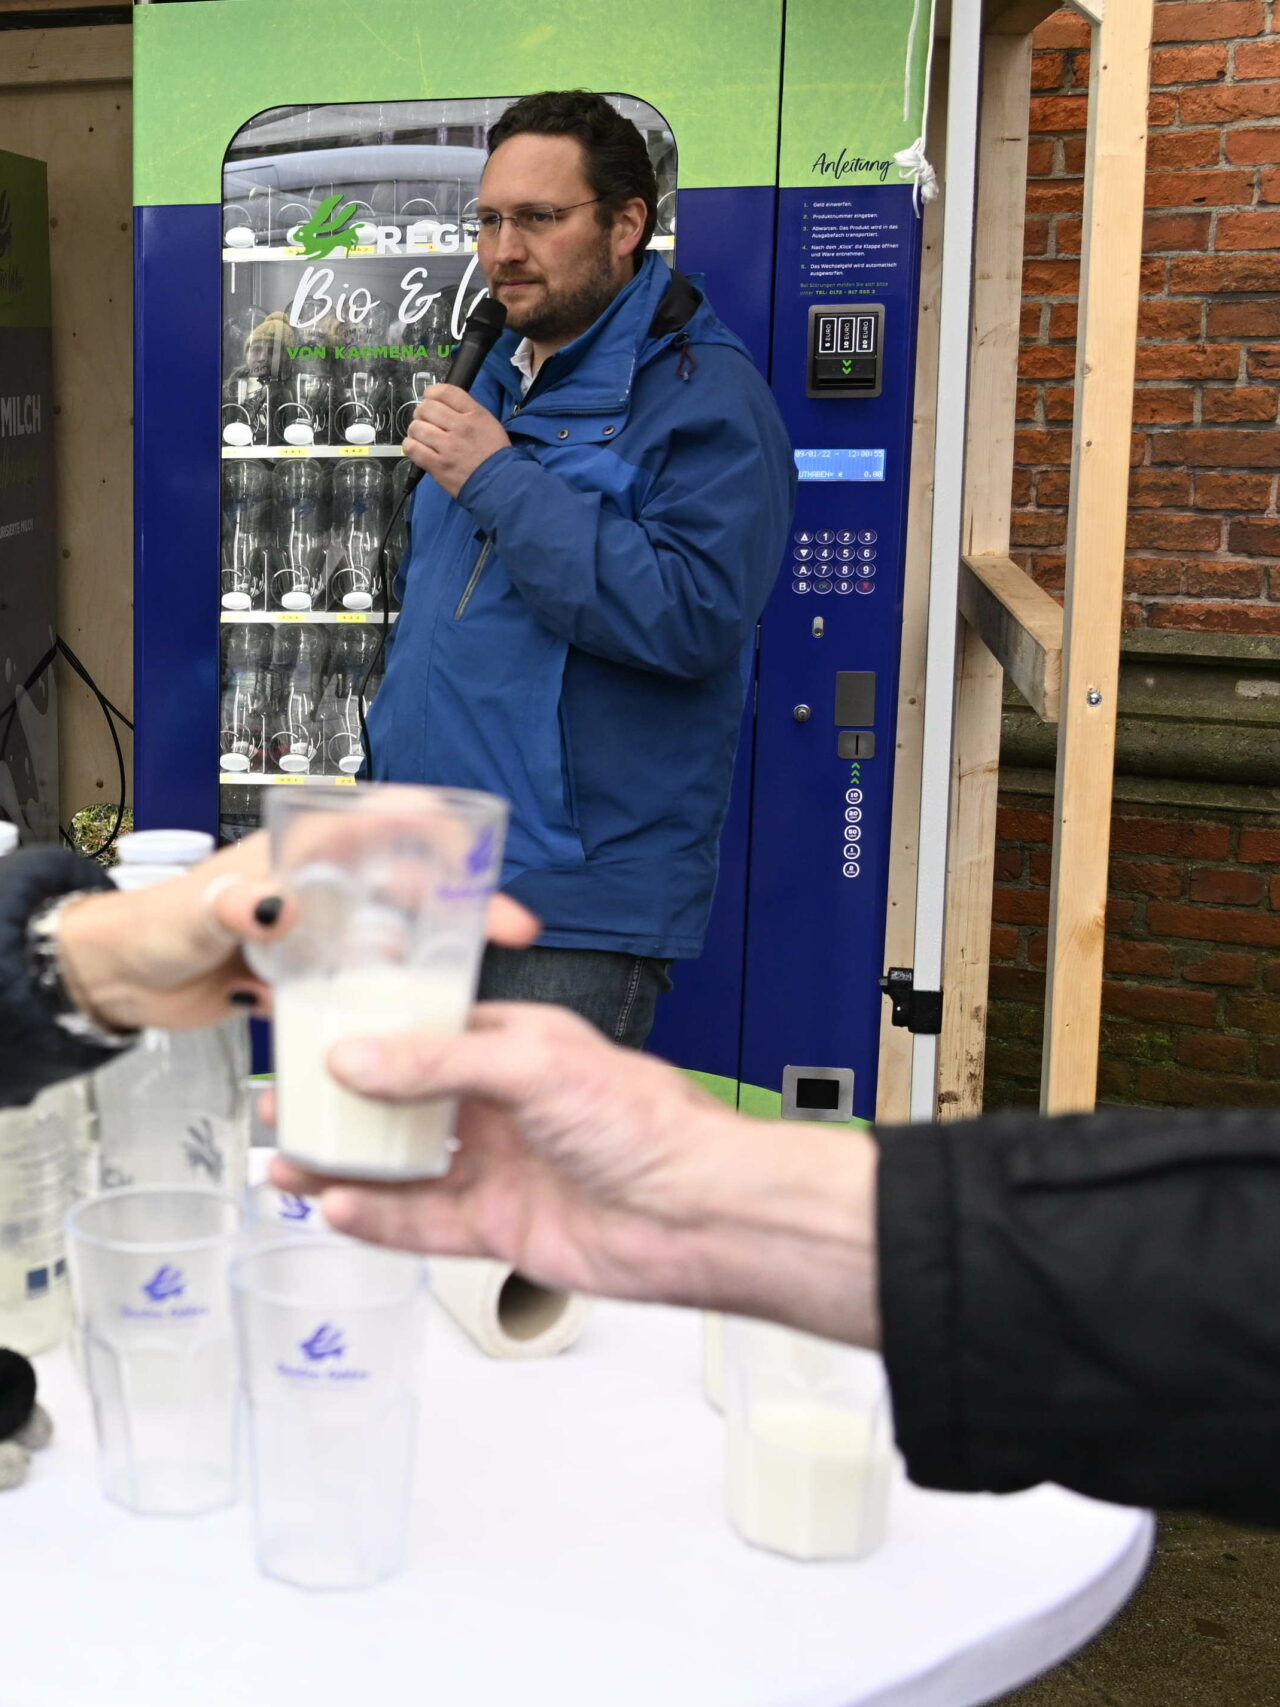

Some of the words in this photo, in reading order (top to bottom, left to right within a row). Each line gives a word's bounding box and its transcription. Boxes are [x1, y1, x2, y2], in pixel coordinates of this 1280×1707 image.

[812, 148, 894, 182] Anleitung
[289, 266, 380, 328] Bio
[398, 267, 441, 324] &
[286, 346, 326, 360] VON
[2, 395, 42, 438] MILCH
[822, 550, 828, 558] 4
[842, 549, 849, 558] 5
[864, 549, 870, 558] 6
[799, 566, 807, 574] A
[822, 566, 828, 574] 7
[842, 566, 848, 574] 8
[863, 566, 870, 574] 9
[799, 582, 806, 590] B
[841, 582, 848, 590] 0
